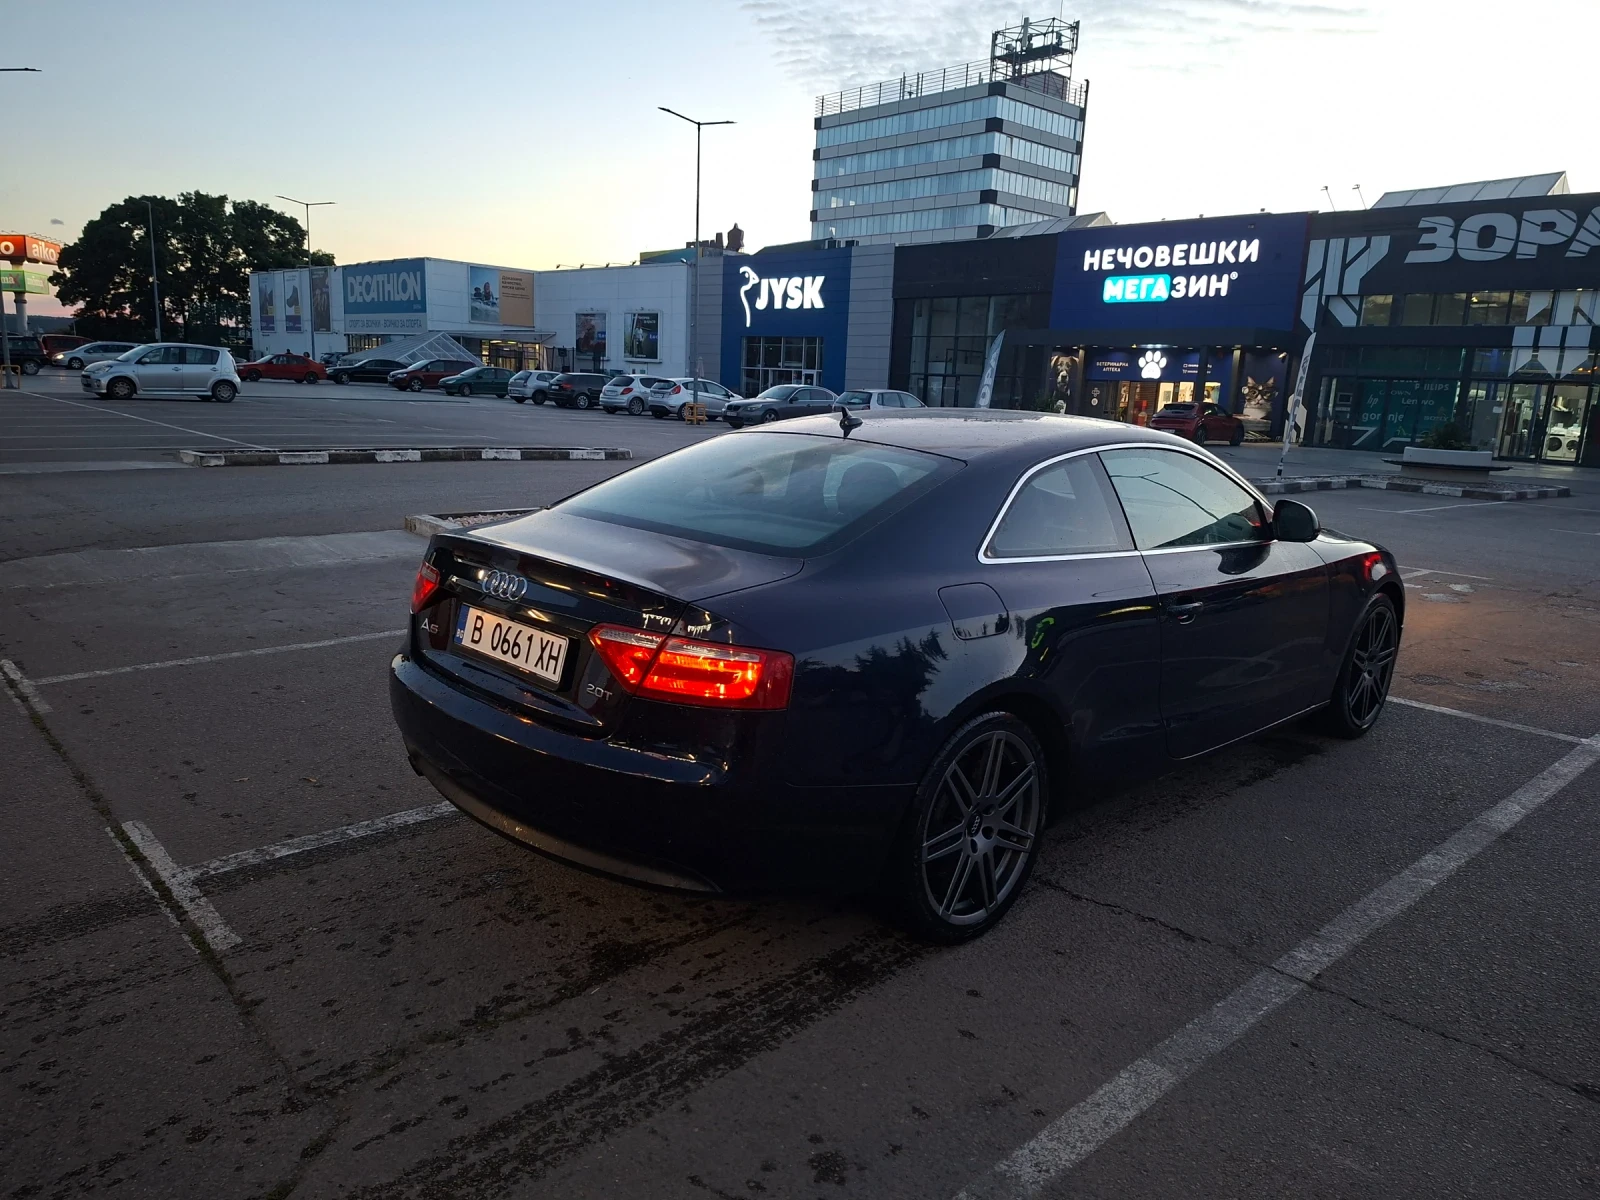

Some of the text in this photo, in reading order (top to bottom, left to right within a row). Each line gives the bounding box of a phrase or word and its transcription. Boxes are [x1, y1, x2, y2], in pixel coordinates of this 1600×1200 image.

[32, 241, 56, 261] aiko
[1083, 239, 1260, 271] НЕЧОВЕШКИ
[347, 271, 421, 303] DECATHLON
[755, 276, 825, 310] JYSK
[1366, 394, 1379, 408] hp
[1362, 412, 1404, 423] gornje
[420, 617, 439, 634] A5
[456, 628, 465, 639] BG
[470, 615, 485, 645] B
